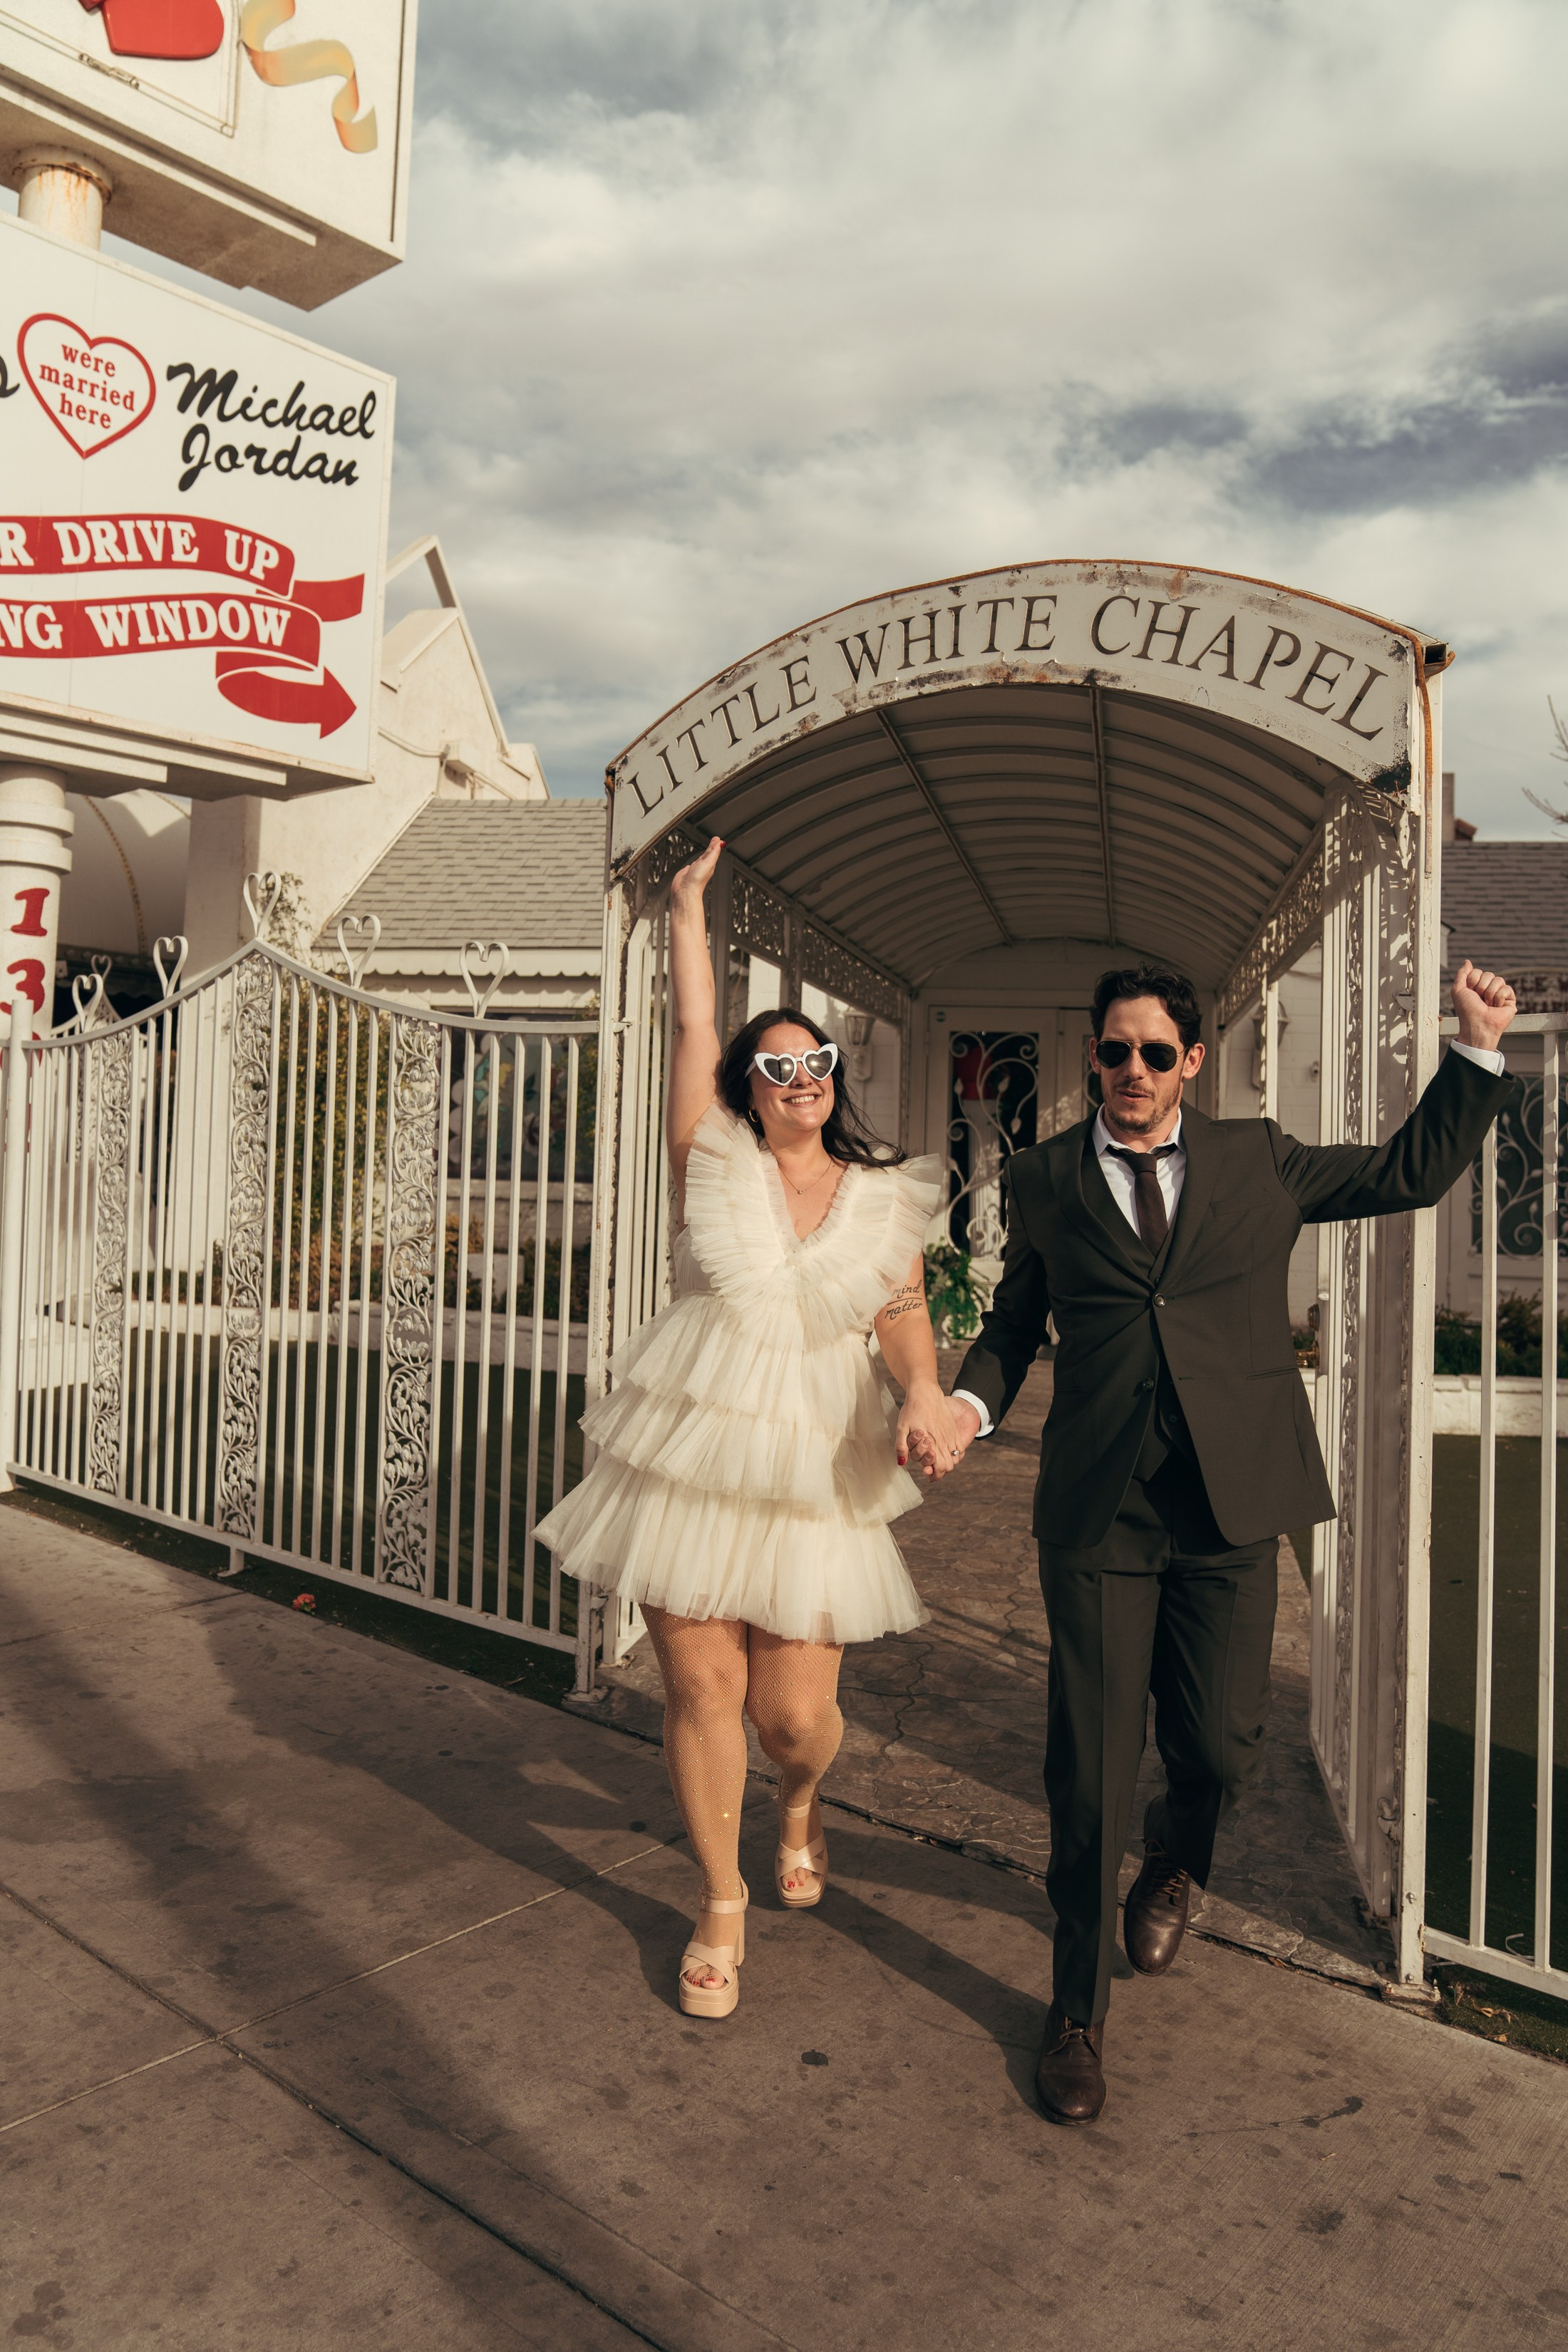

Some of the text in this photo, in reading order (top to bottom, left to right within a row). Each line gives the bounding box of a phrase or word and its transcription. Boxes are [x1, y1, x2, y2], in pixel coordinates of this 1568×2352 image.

[61, 344, 115, 377] were
[39, 364, 135, 412] married
[59, 393, 111, 429] here
[166, 362, 376, 439] Michael
[178, 423, 359, 492] Jordan
[0, 520, 279, 581] R DRIVE UP
[0, 599, 291, 650] NG WINDOW
[626, 594, 1389, 819] LITTLE WHITE CHAPEL
[884, 1300, 923, 1320] matter
